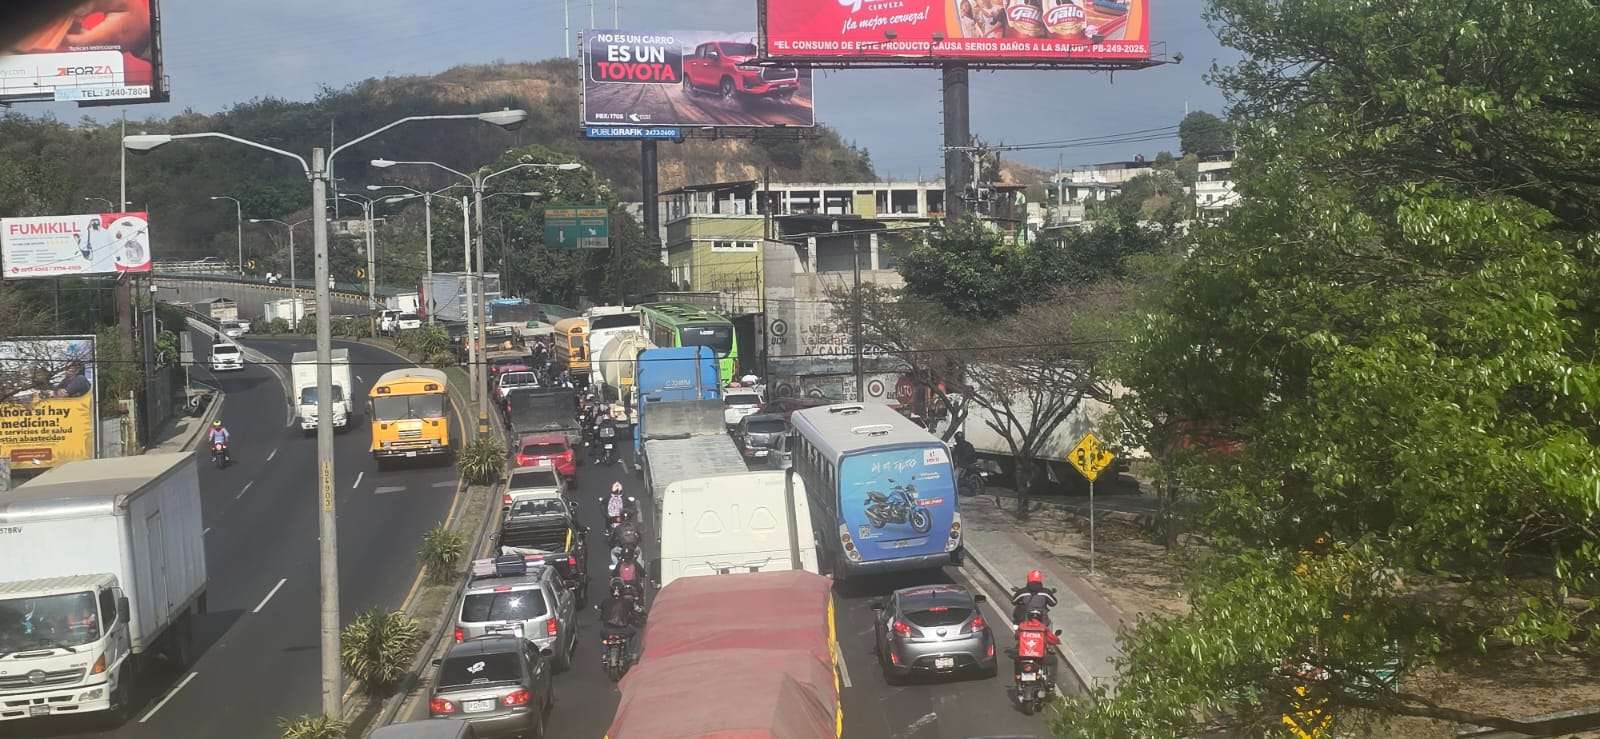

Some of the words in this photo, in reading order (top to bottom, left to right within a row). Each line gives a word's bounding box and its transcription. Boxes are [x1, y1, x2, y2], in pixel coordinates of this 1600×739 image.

[867, 2, 904, 11] CERVEZA
[859, 16, 888, 30] mejor
[889, 6, 930, 25] cerveza!
[1047, 8, 1084, 26] Gallo
[597, 34, 612, 43] NO
[614, 35, 625, 44] ES
[626, 35, 641, 44] UN
[642, 36, 674, 45] CARRO
[792, 41, 839, 50] CONSUMO
[841, 41, 854, 50] DE
[856, 41, 879, 50] ESTE
[881, 41, 931, 50] PRODUCTO
[932, 42, 962, 50] CAUSA
[965, 42, 998, 51] SERIOS
[1000, 42, 1030, 51] DAÑOS
[1033, 42, 1039, 51] A
[1042, 43, 1053, 51] LA
[607, 46, 631, 62] ES
[636, 46, 664, 63] UN
[66, 65, 113, 76] FORZA
[597, 63, 676, 80] TOYOTA
[105, 89, 148, 97] 2440-7804
[10, 222, 80, 235] FUMIKILL
[0, 406, 33, 418] hora
[35, 405, 46, 416] sí
[48, 405, 70, 418] hay
[1, 417, 60, 428] medicina!
